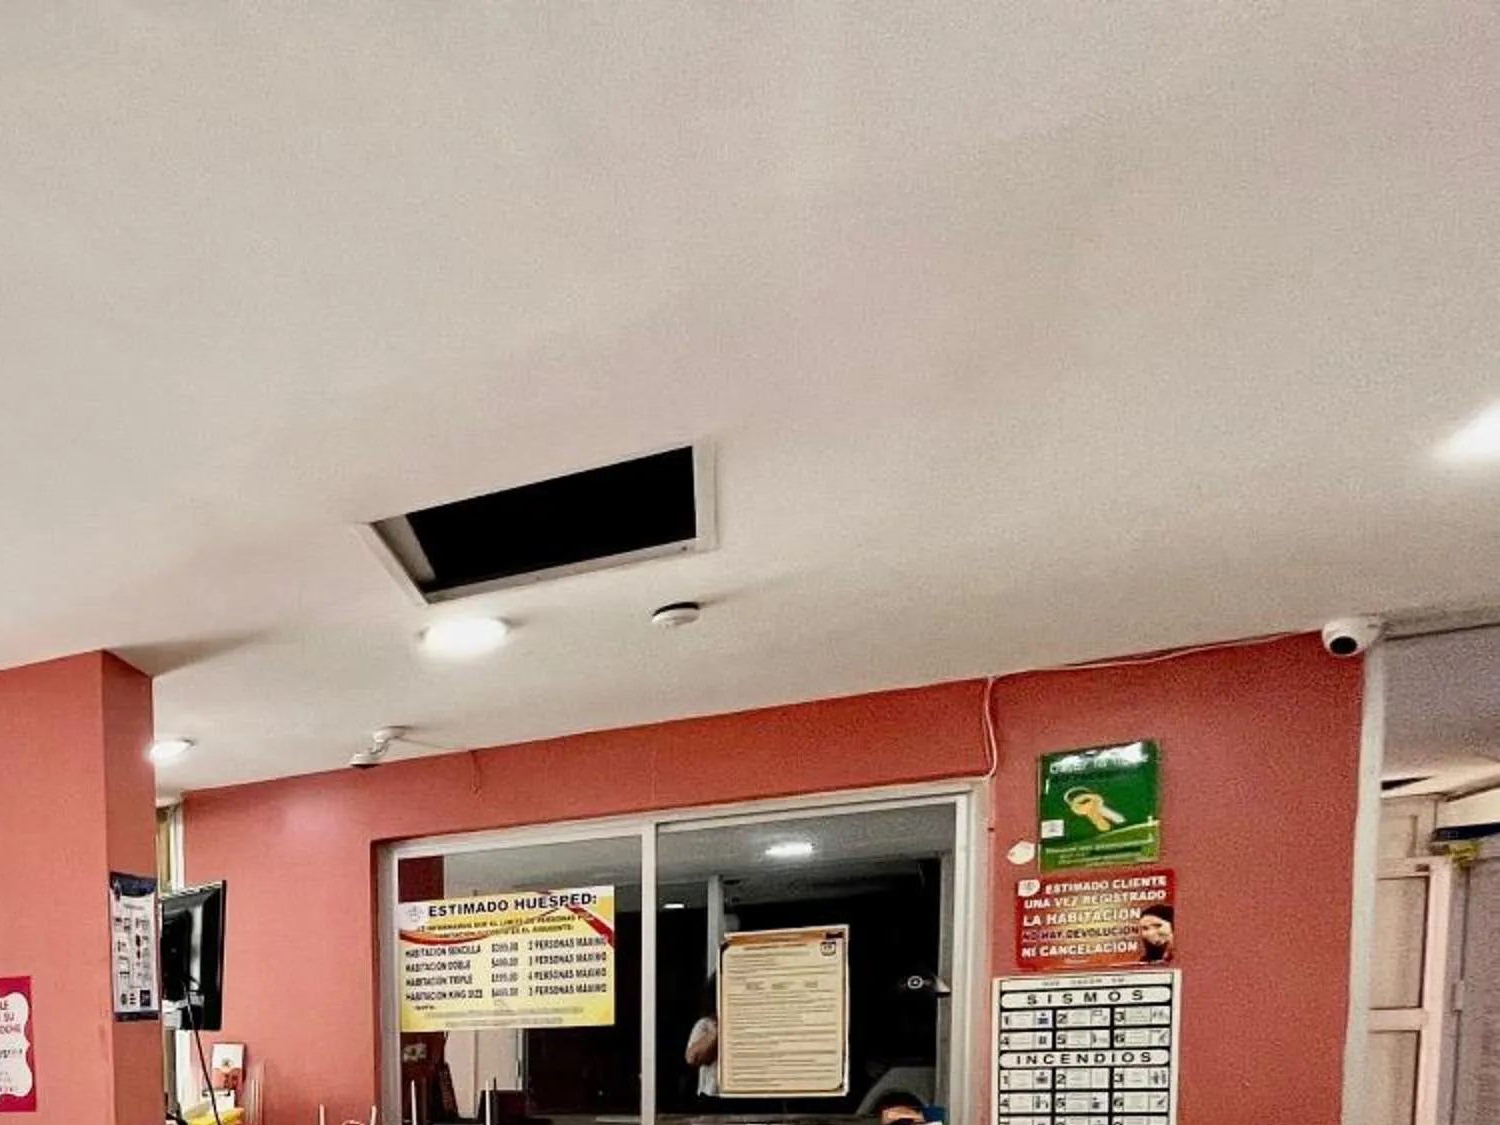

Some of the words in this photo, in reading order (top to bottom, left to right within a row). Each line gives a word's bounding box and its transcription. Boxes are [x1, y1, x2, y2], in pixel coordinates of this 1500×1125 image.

[1045, 880, 1109, 895] ESTIMADO
[1112, 875, 1167, 889] CLIENTE
[1024, 898, 1050, 909] UNA
[1055, 896, 1078, 908] VEZ
[1083, 889, 1166, 905] REGISTRADO
[428, 899, 509, 917] ESTIMADO
[1023, 915, 1041, 927] LA
[1022, 946, 1036, 958] NI
[1027, 989, 1144, 1006] SISMOS
[1016, 1051, 1152, 1065] INCENDIOS
